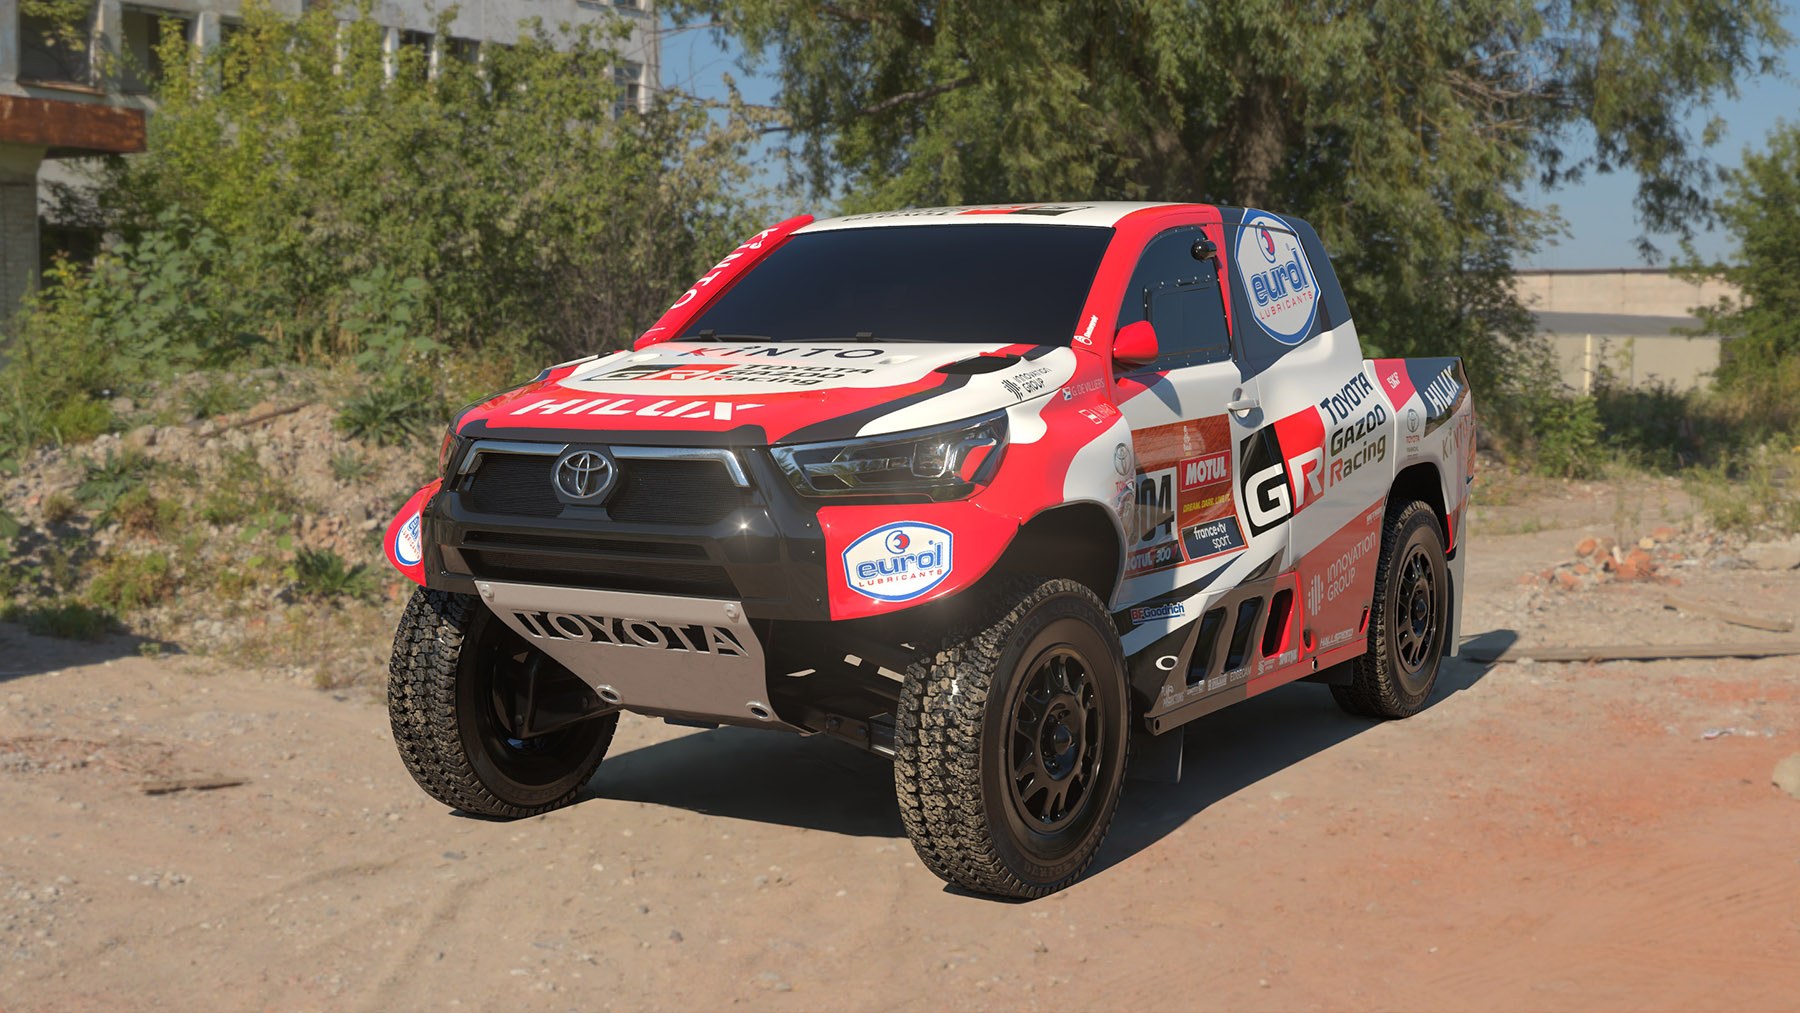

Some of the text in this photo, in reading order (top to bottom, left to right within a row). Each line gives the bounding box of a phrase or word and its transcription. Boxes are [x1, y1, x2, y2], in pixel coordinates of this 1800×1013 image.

[1250, 246, 1309, 307] eurol
[1260, 291, 1313, 320] LUBRICANTS
[588, 368, 698, 381] GR
[705, 375, 820, 386] Racing
[718, 370, 846, 379] GAZOO
[743, 364, 875, 374] TOYOTA
[1386, 372, 1401, 389] SKF
[1022, 378, 1046, 394] GROUP
[1320, 372, 1373, 425] TOYOTA
[1424, 365, 1460, 417] HILUX
[509, 399, 766, 421] HILUX
[1330, 404, 1386, 457] GAZOO
[1185, 456, 1227, 486] MOTUL
[1330, 434, 1386, 487] Racing
[1245, 446, 1323, 527] GR
[1156, 547, 1172, 563] 300
[1212, 534, 1232, 551] sport
[856, 541, 943, 580] eurol
[858, 569, 943, 587] LUBRICANTS
[1327, 567, 1356, 601] GROUP
[510, 609, 749, 657] TOYOTA
